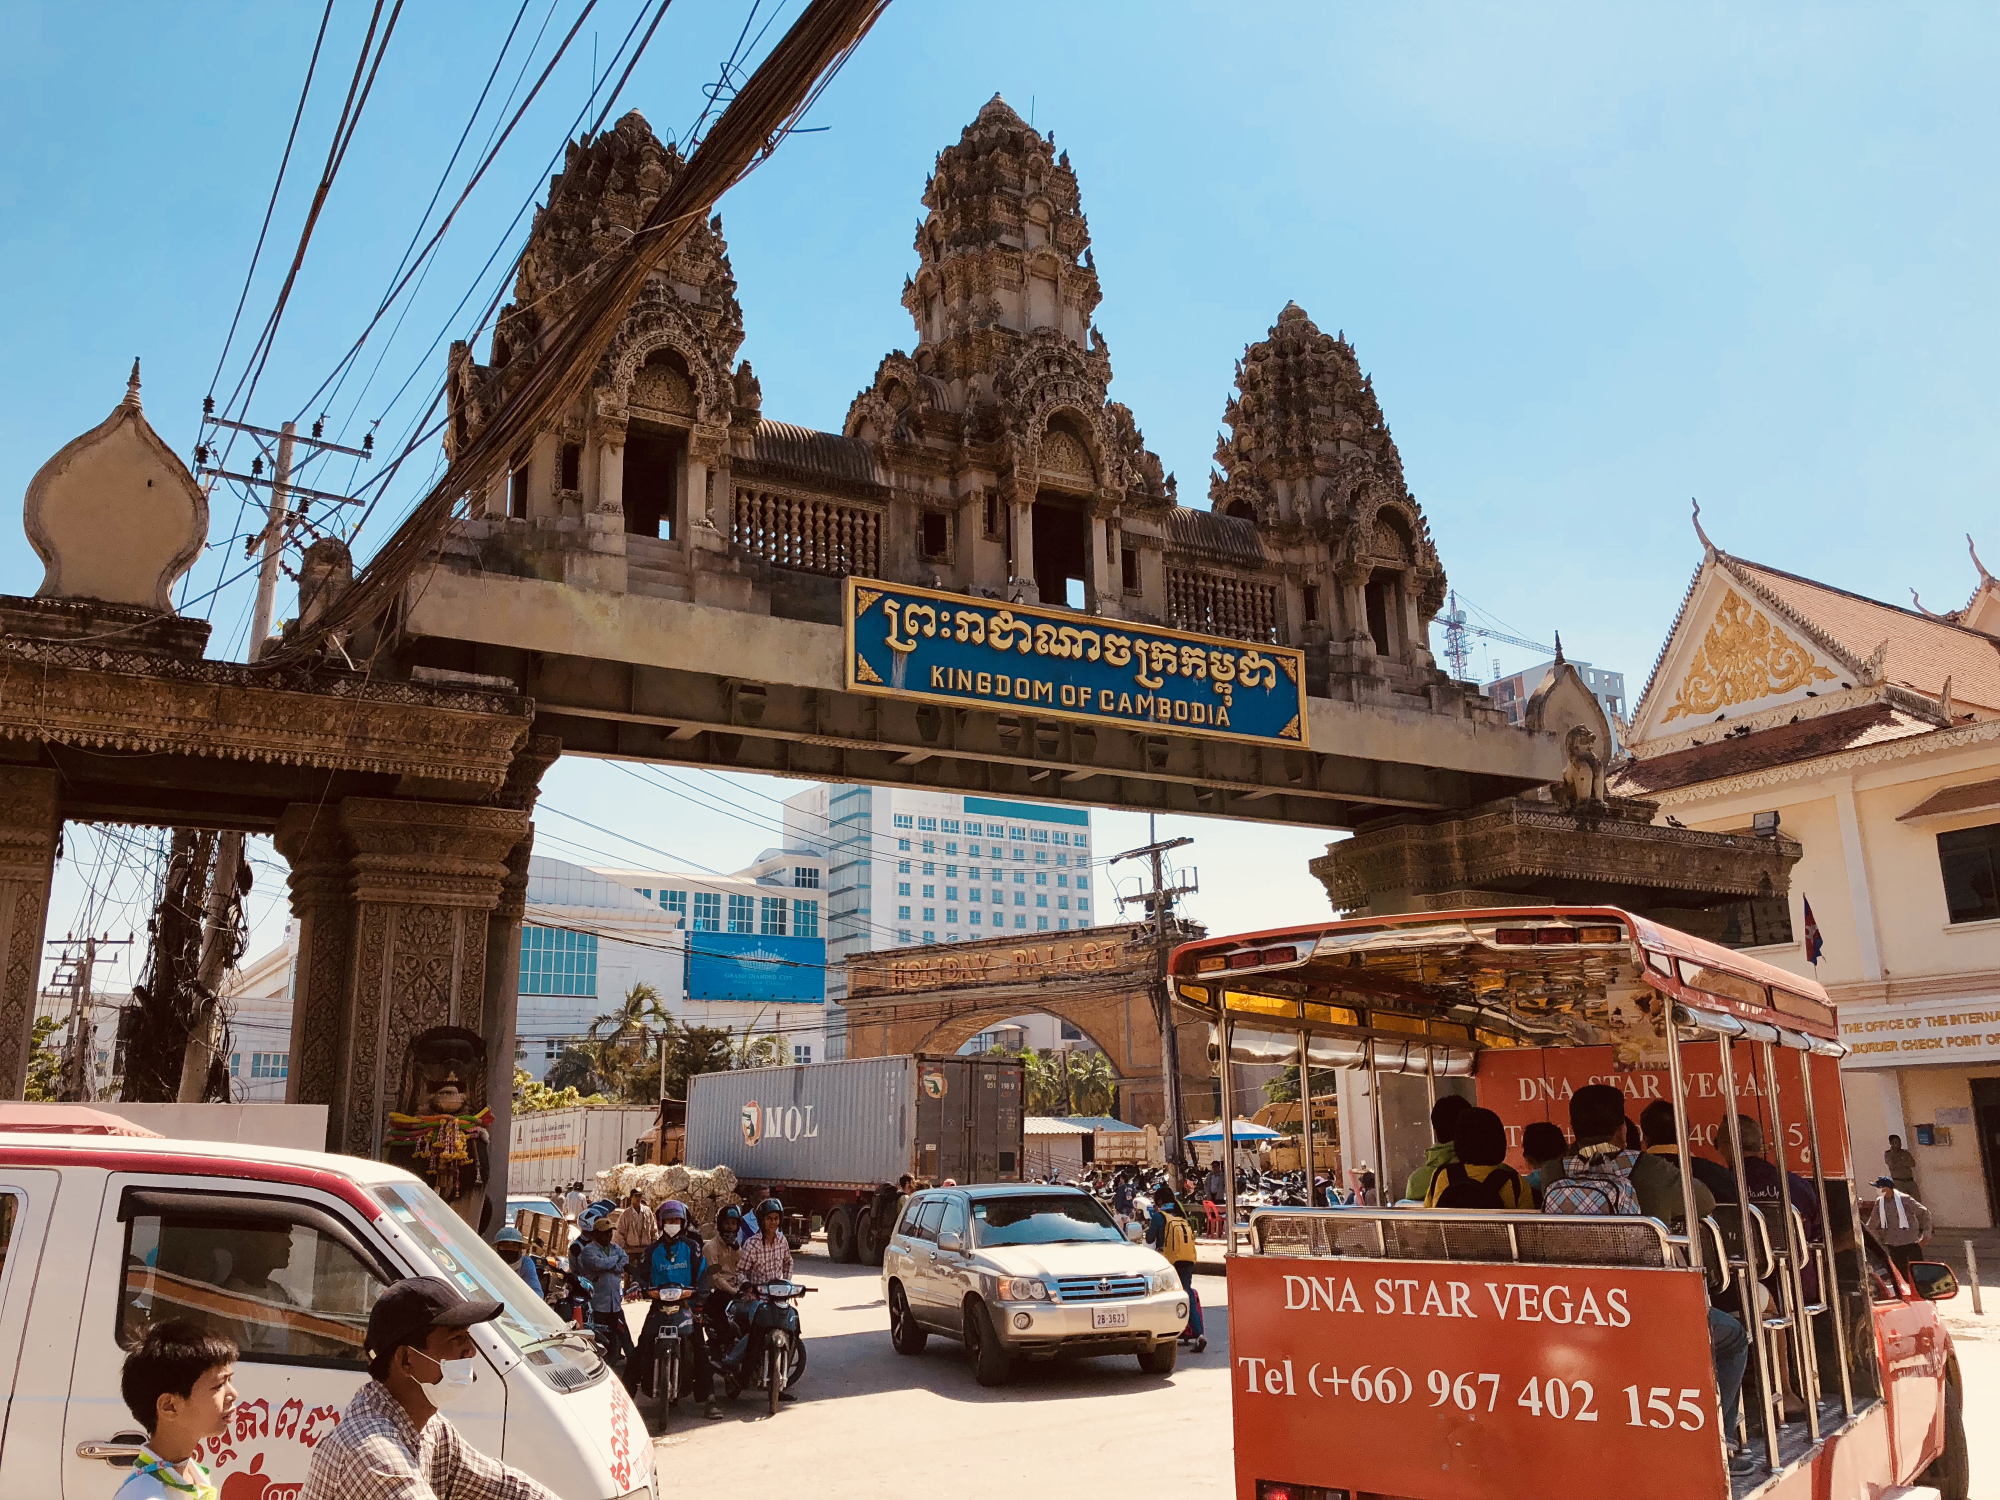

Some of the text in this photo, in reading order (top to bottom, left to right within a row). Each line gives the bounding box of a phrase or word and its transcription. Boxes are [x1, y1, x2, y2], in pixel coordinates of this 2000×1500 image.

[930, 665, 1231, 727] KINGDOM OF CAMBODIA
[891, 940, 1117, 989] HOLIDAY PALACE
[1841, 1022, 1864, 1034] THE
[1865, 1018, 1905, 1032] OFFICE
[1906, 1017, 1921, 1029] OF
[1924, 1015, 1948, 1027] THE
[1852, 1040, 1900, 1054] BORDER
[1901, 1037, 1944, 1051] CHECK
[1946, 1034, 1982, 1048] POINT
[1517, 1077, 1575, 1102] DNA
[764, 1105, 818, 1142] MOL
[1284, 1275, 1632, 1328] DNA STAR VEGAS
[1238, 1356, 1706, 1431] Tel (+66) 967 402 155
